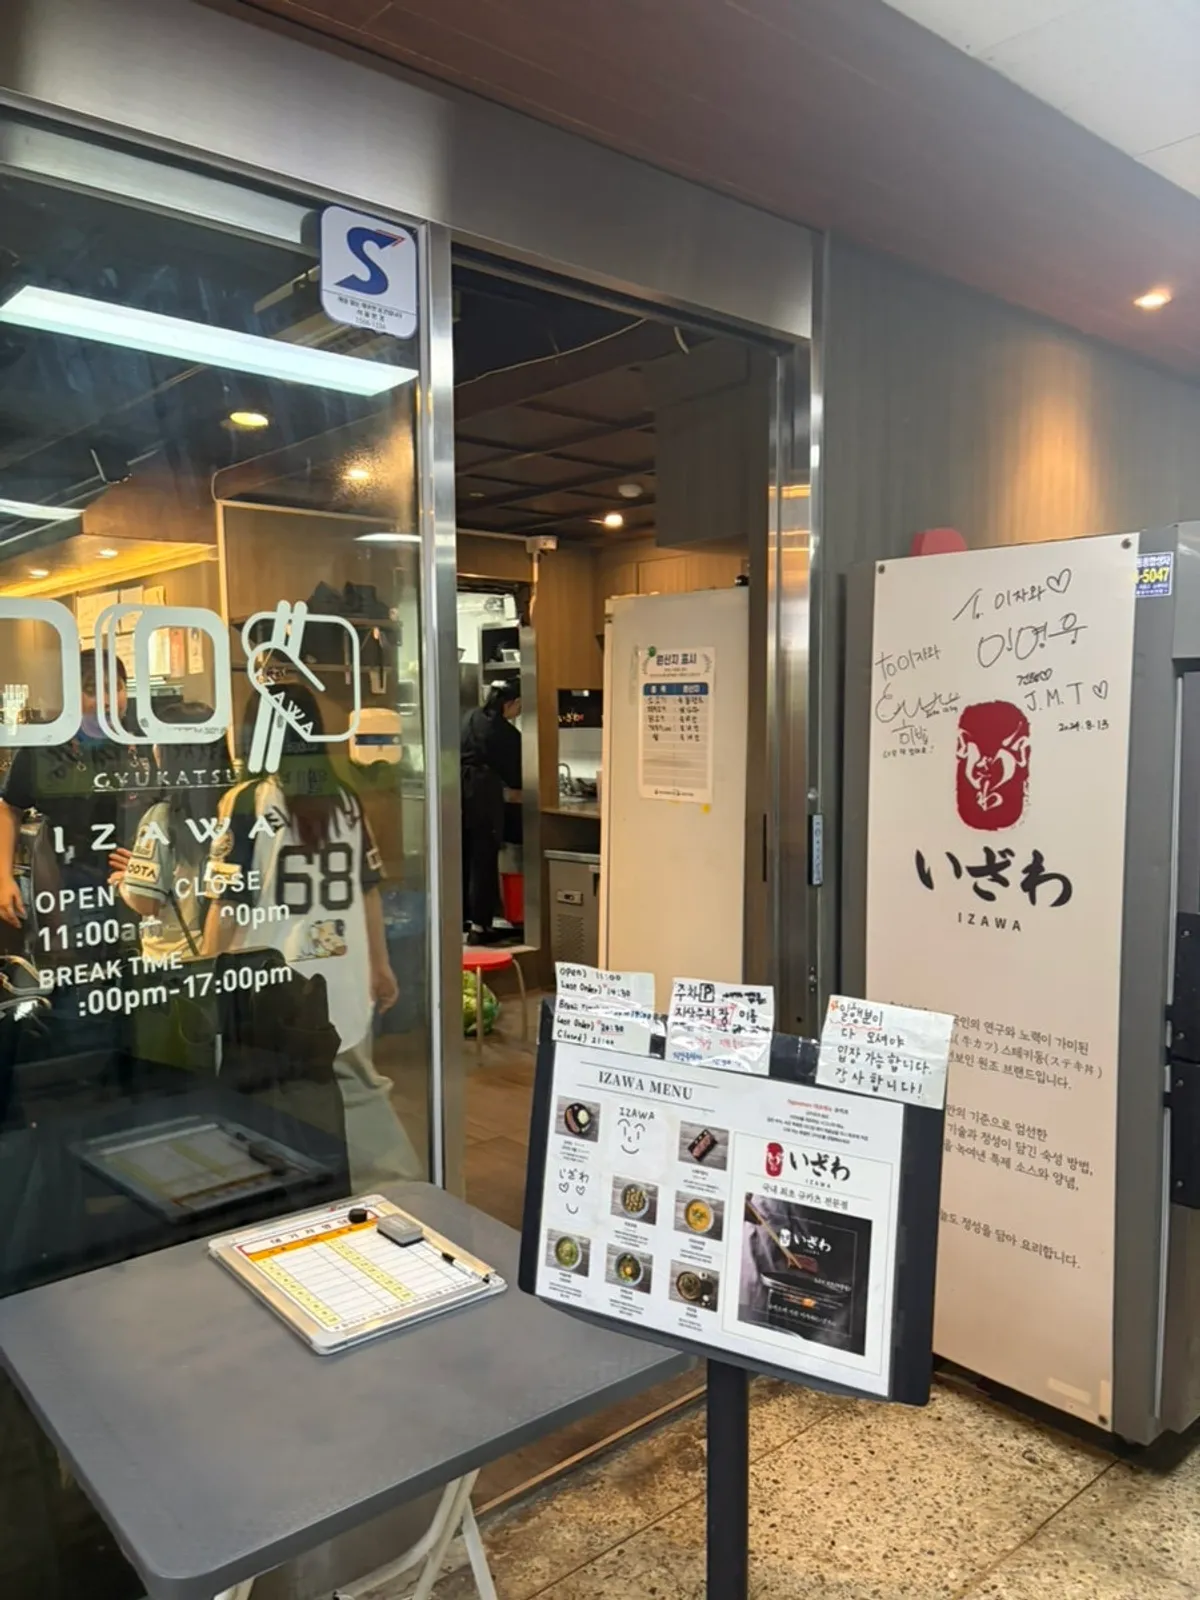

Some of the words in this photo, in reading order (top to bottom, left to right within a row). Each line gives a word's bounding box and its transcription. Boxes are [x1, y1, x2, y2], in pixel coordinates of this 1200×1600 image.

[1132, 567, 1169, 583] -5047
[93, 769, 240, 788] GYUKATSU
[53, 814, 276, 853] IZAWA
[175, 870, 260, 899] CLOSE
[275, 843, 353, 915] 68
[915, 846, 1073, 907] いざわ
[35, 886, 115, 913] OPEN
[957, 912, 1021, 932] IZAWA
[39, 959, 123, 989] BREAK
[128, 951, 183, 976] TIME
[675, 983, 698, 1001] 주차
[840, 1002, 883, 1026] 일행분이
[841, 1027, 856, 1040] 다
[984, 1020, 1016, 1038] 연구와
[1018, 1029, 1052, 1047] 노력이
[1054, 1036, 1089, 1056] 가미된
[837, 1045, 860, 1064] 입장
[598, 1070, 644, 1091] IZAWA
[649, 1080, 692, 1100] MENU
[978, 1055, 1000, 1072] 원조
[1003, 1063, 1072, 1090] 브랜드입니다.
[619, 1106, 655, 1120] IZAWA
[970, 1110, 1012, 1131] 기준으로
[1015, 1122, 1048, 1143] 엄선한
[947, 1122, 978, 1141] 기술과
[981, 1131, 1011, 1151] 정성이
[1015, 1141, 1037, 1158] 담긴
[1040, 1149, 1063, 1167] 숙성
[790, 1152, 850, 1181] いざわ
[955, 1143, 987, 1163] 녹여낸
[1014, 1161, 1049, 1181] 소스와
[961, 1216, 991, 1238] 정성을
[995, 1228, 1017, 1246] 담아
[1020, 1238, 1081, 1270] 요리합니다.
